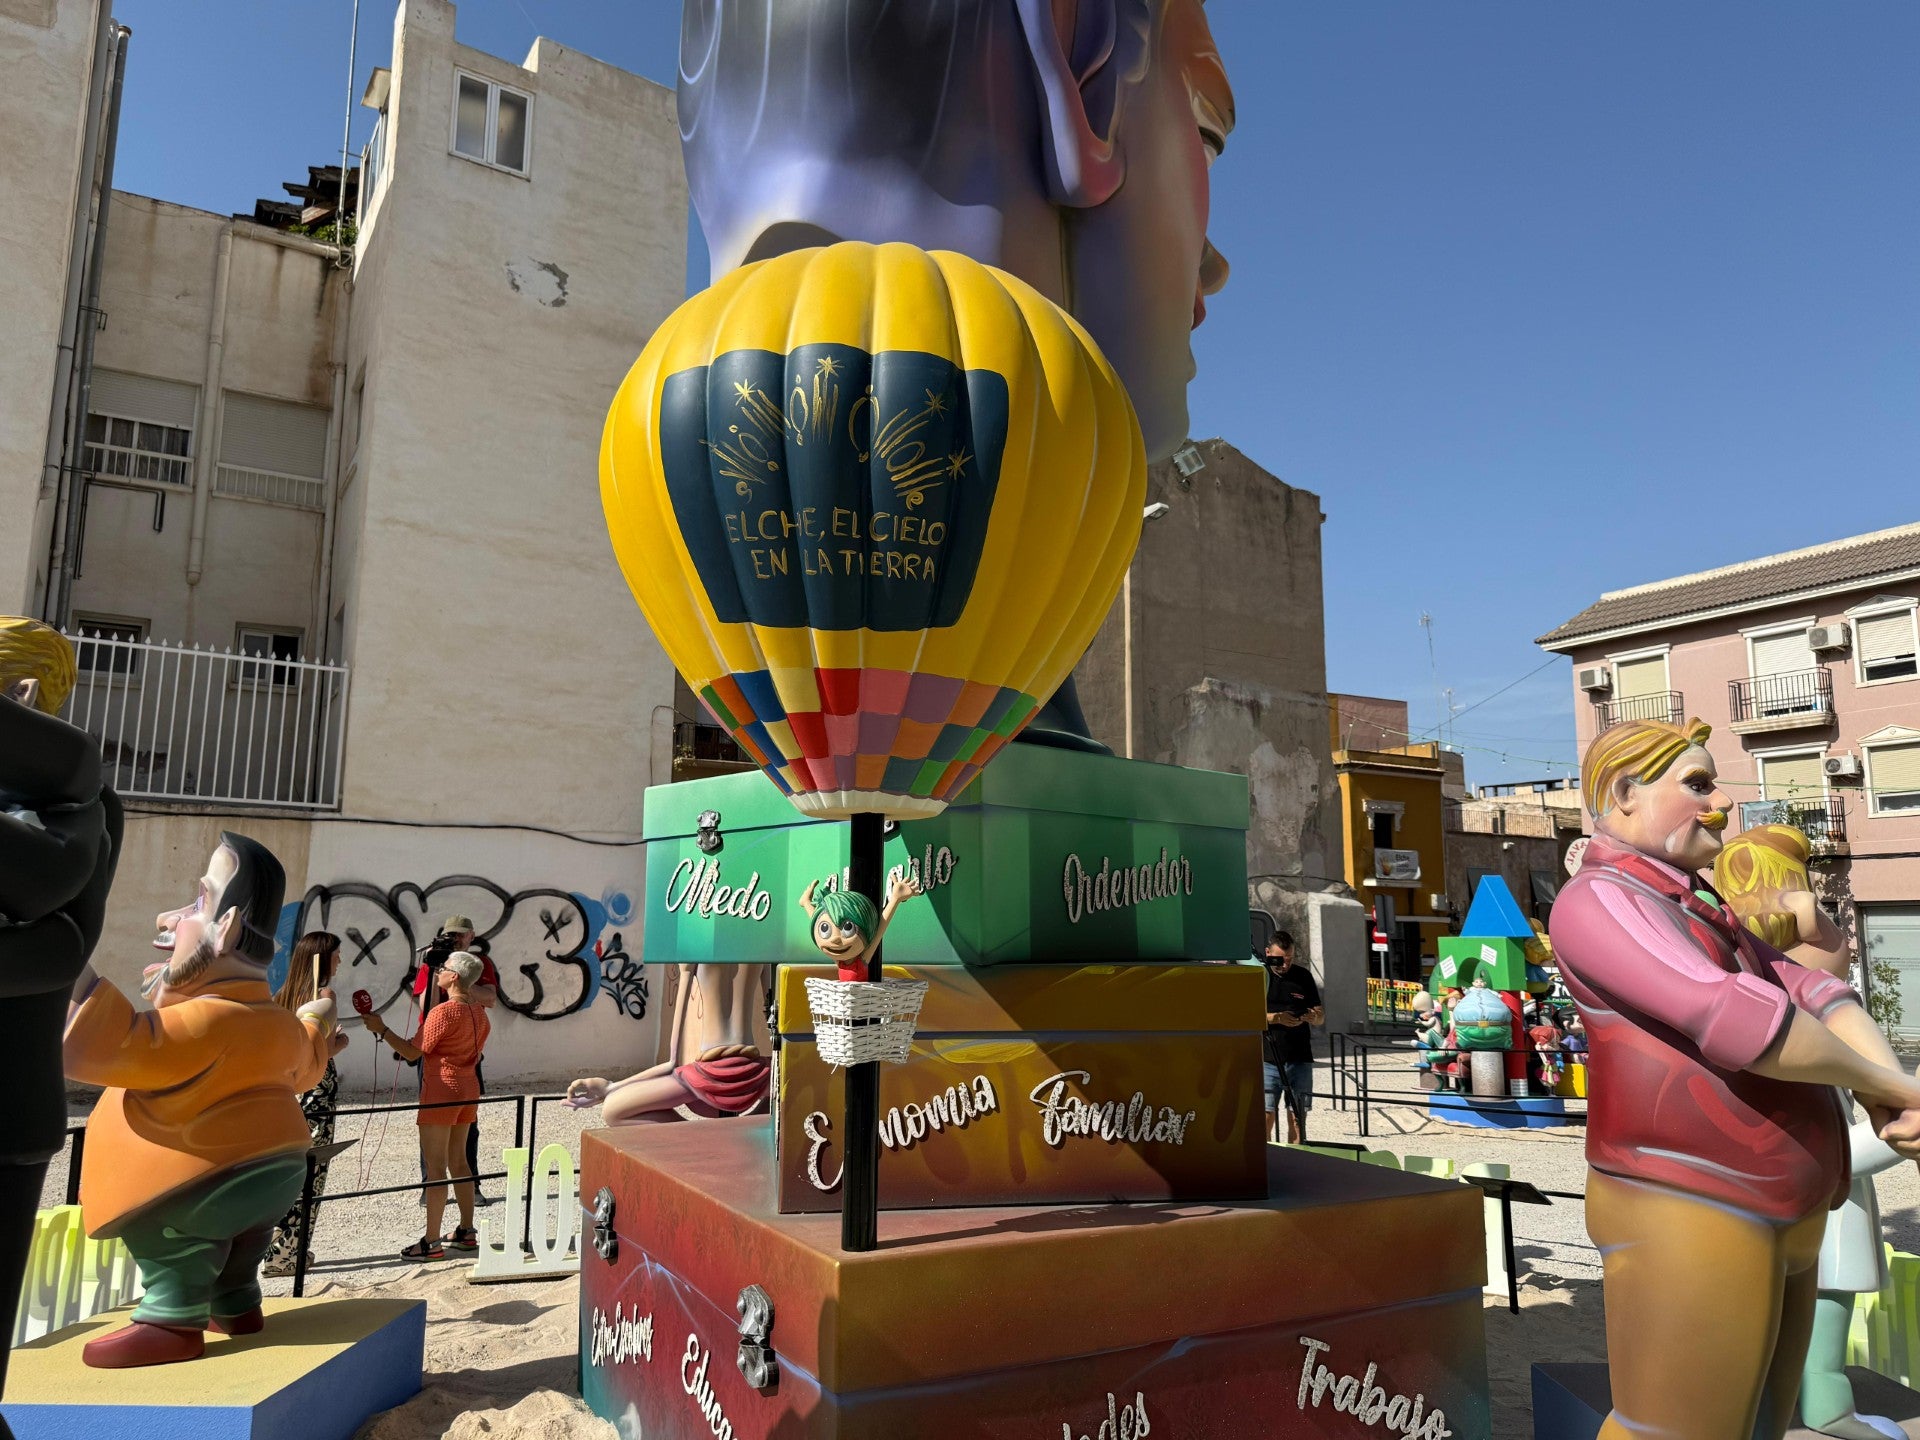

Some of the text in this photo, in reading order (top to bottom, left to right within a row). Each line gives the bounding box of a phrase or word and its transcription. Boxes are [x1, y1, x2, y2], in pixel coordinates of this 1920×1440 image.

[725, 506, 946, 546] ELCHE, EL CIELO
[751, 547, 935, 583] EN LA TIERRA
[665, 856, 771, 922] Miedo
[1063, 847, 1194, 923] Ordenador
[803, 1070, 1196, 1191] Enomia Familiar
[682, 1333, 738, 1440] Educa
[1297, 1336, 1453, 1440] Trabajo
